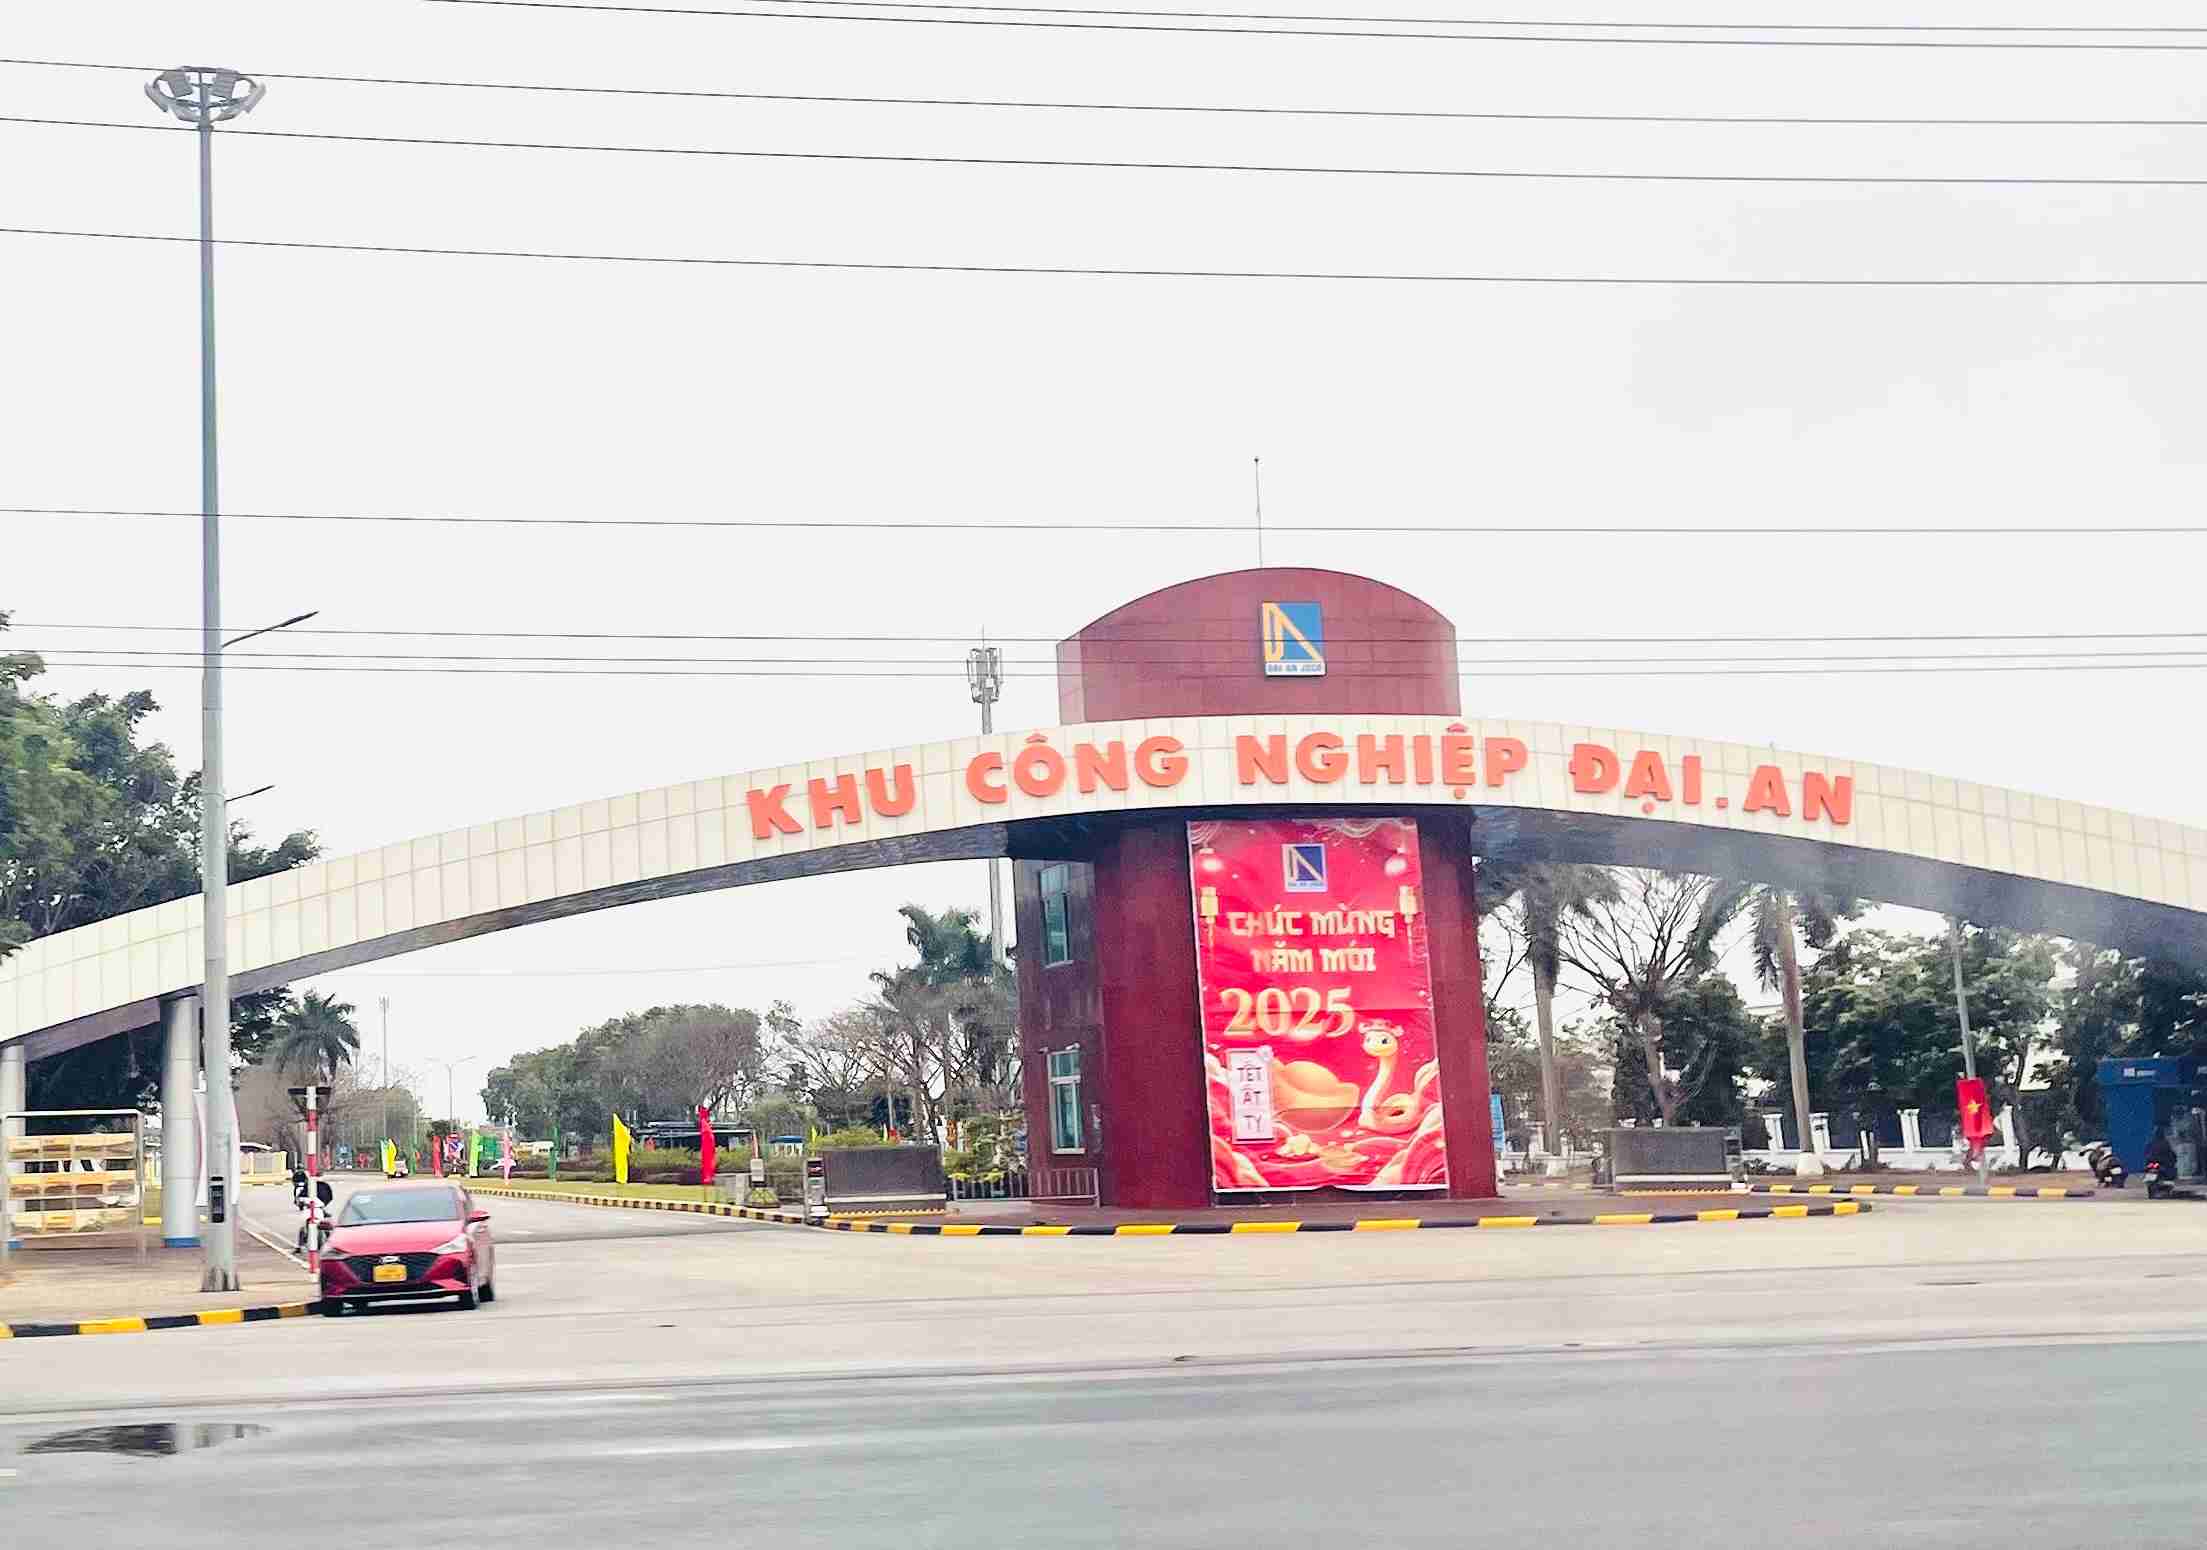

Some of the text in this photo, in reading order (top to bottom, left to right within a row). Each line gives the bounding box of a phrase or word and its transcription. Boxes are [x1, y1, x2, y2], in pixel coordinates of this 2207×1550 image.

[745, 764, 916, 840] KHU
[966, 730, 1190, 805] CÔNG
[1236, 722, 1529, 800] NGHIỆP
[1226, 903, 1304, 937] CHÚC
[1250, 940, 1314, 973] NĂM
[1219, 986, 1356, 1039] 2025
